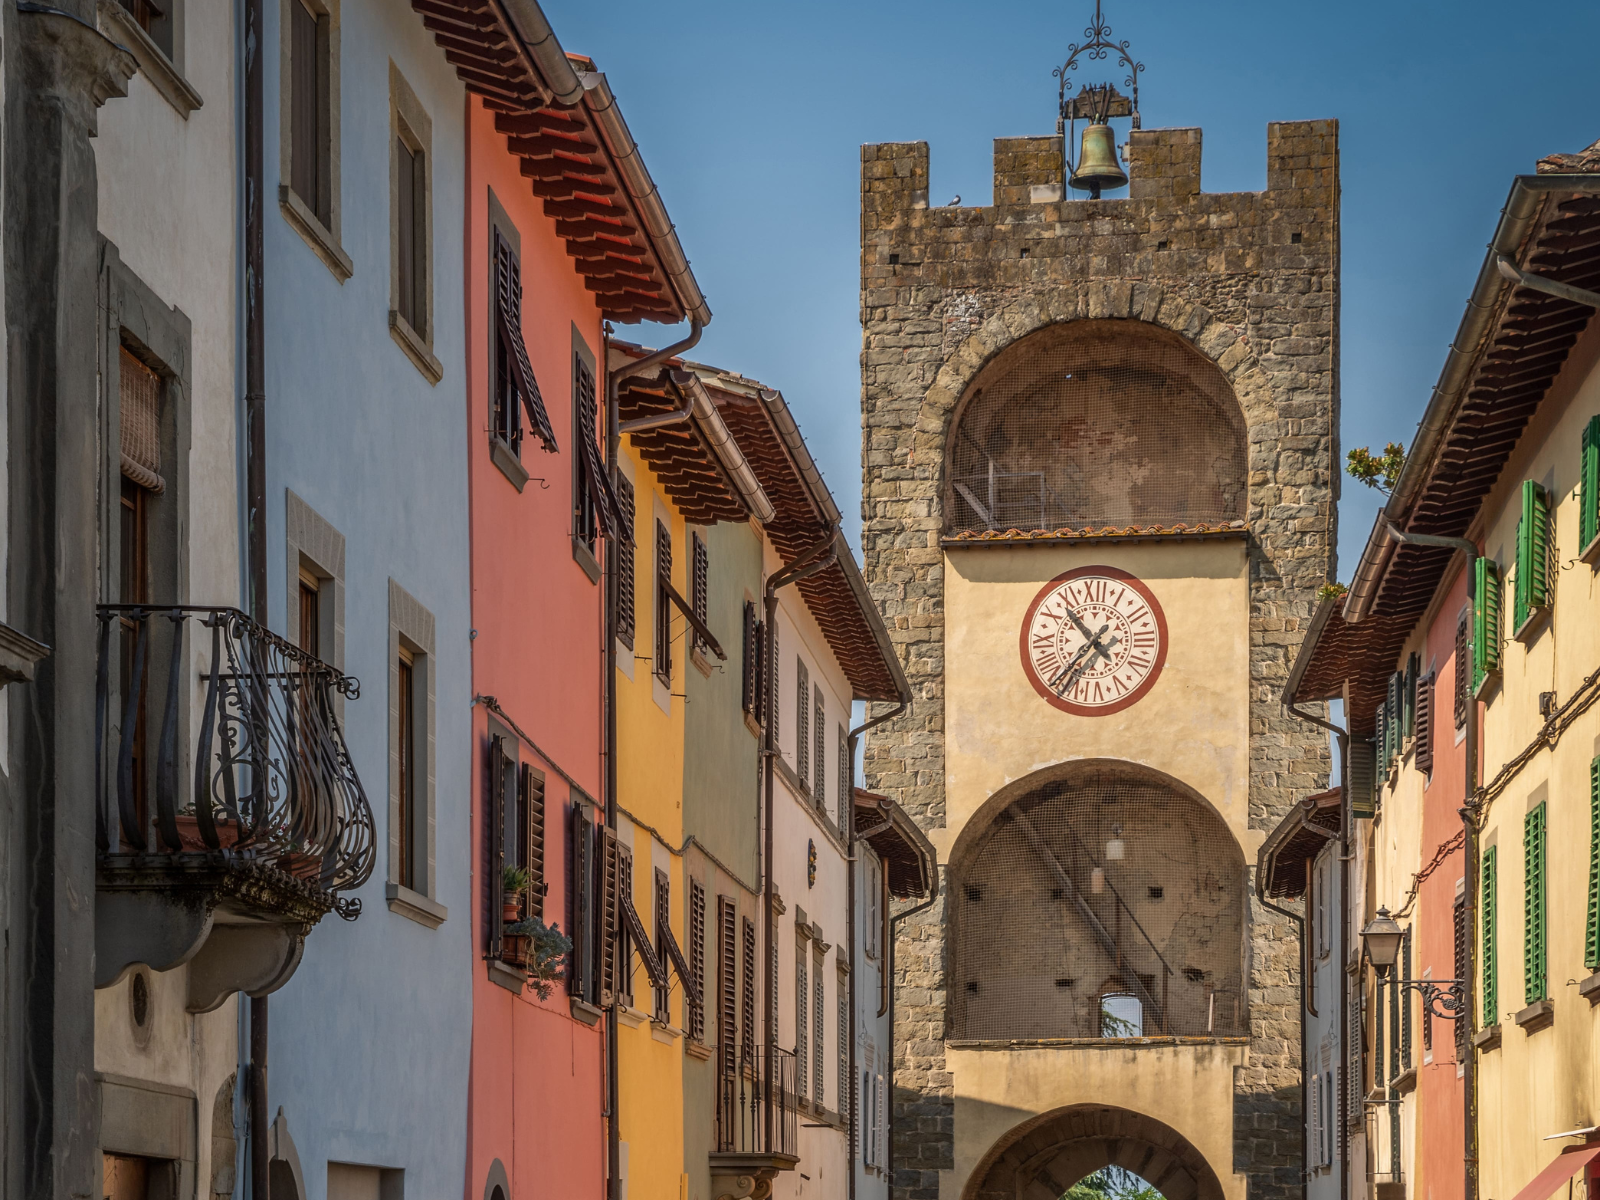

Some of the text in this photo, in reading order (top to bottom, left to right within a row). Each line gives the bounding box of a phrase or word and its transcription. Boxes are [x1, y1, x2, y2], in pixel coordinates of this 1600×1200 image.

[1057, 585, 1080, 608] XI
[1084, 580, 1107, 603] XII
[1113, 587, 1126, 608] I
[1040, 605, 1063, 626] X
[1126, 604, 1149, 625] II
[1033, 633, 1055, 649] IX
[1133, 630, 1155, 649] III
[1127, 654, 1151, 678] IV
[1083, 681, 1105, 702] VI
[1112, 675, 1130, 696] V
